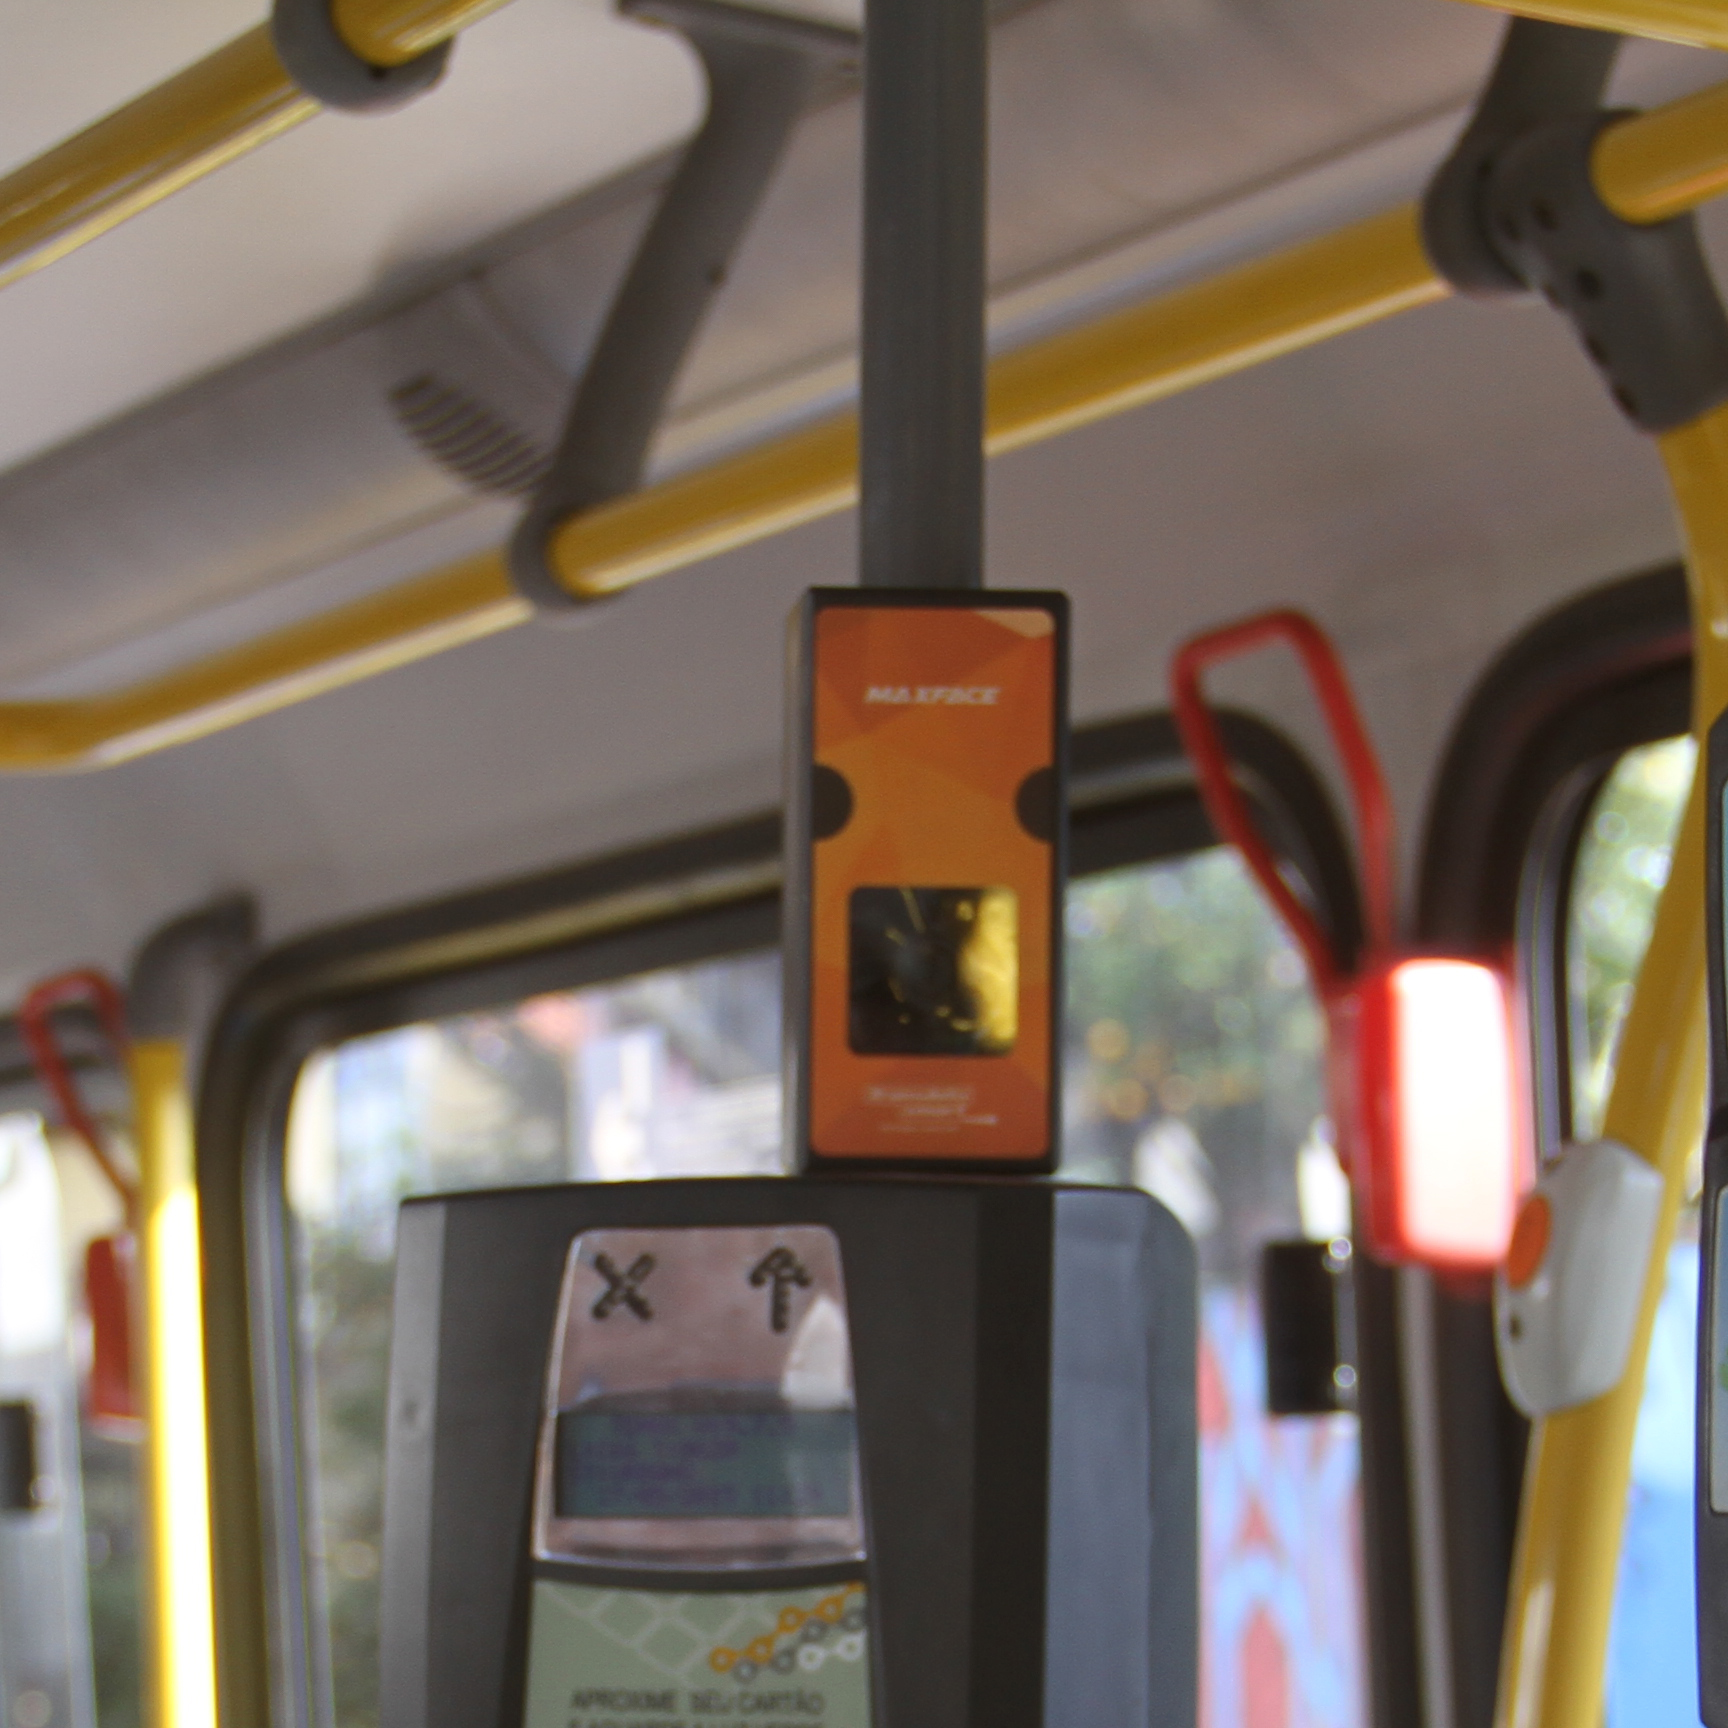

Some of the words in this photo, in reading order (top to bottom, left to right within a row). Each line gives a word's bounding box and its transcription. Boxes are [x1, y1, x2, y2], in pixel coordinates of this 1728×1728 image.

[572, 1689, 677, 1714] APROXIME
[689, 1689, 732, 1715] SEU
[737, 1687, 826, 1716] CARTÃO
